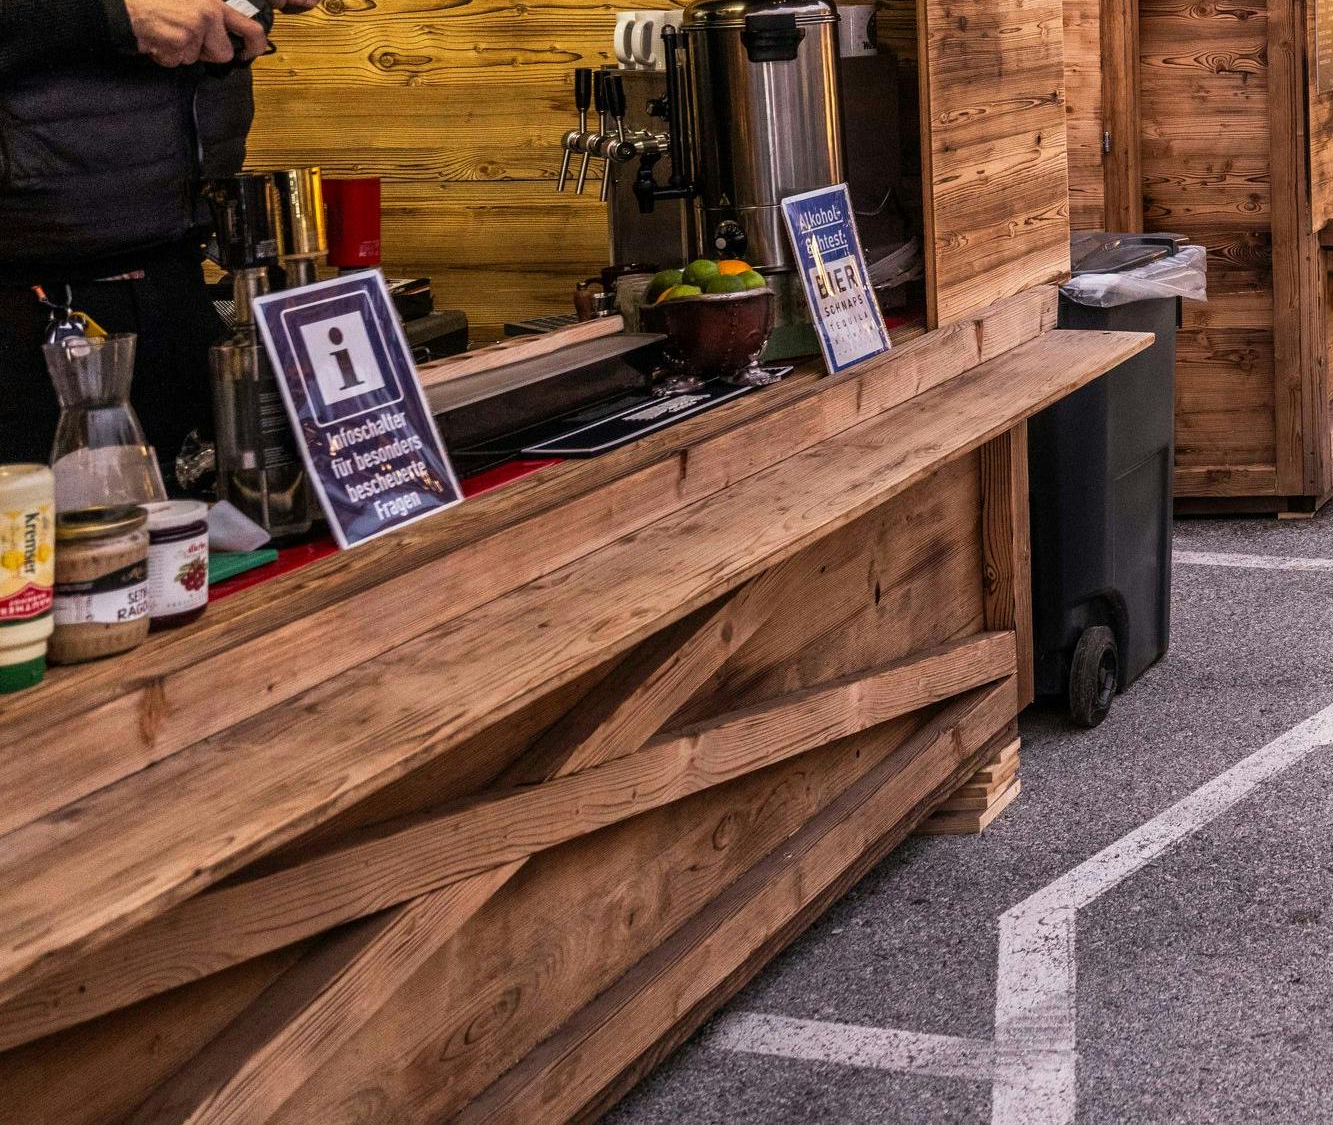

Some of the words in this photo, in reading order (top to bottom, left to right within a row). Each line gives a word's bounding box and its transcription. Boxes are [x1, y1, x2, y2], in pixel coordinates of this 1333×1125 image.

[815, 265, 858, 299] BIER
[824, 294, 863, 317] SCHNAPS
[326, 411, 406, 451] Infoschalter
[331, 458, 353, 479] für
[356, 434, 423, 471] besonders
[345, 460, 428, 503] bescheuerte
[375, 490, 422, 520] Fragen
